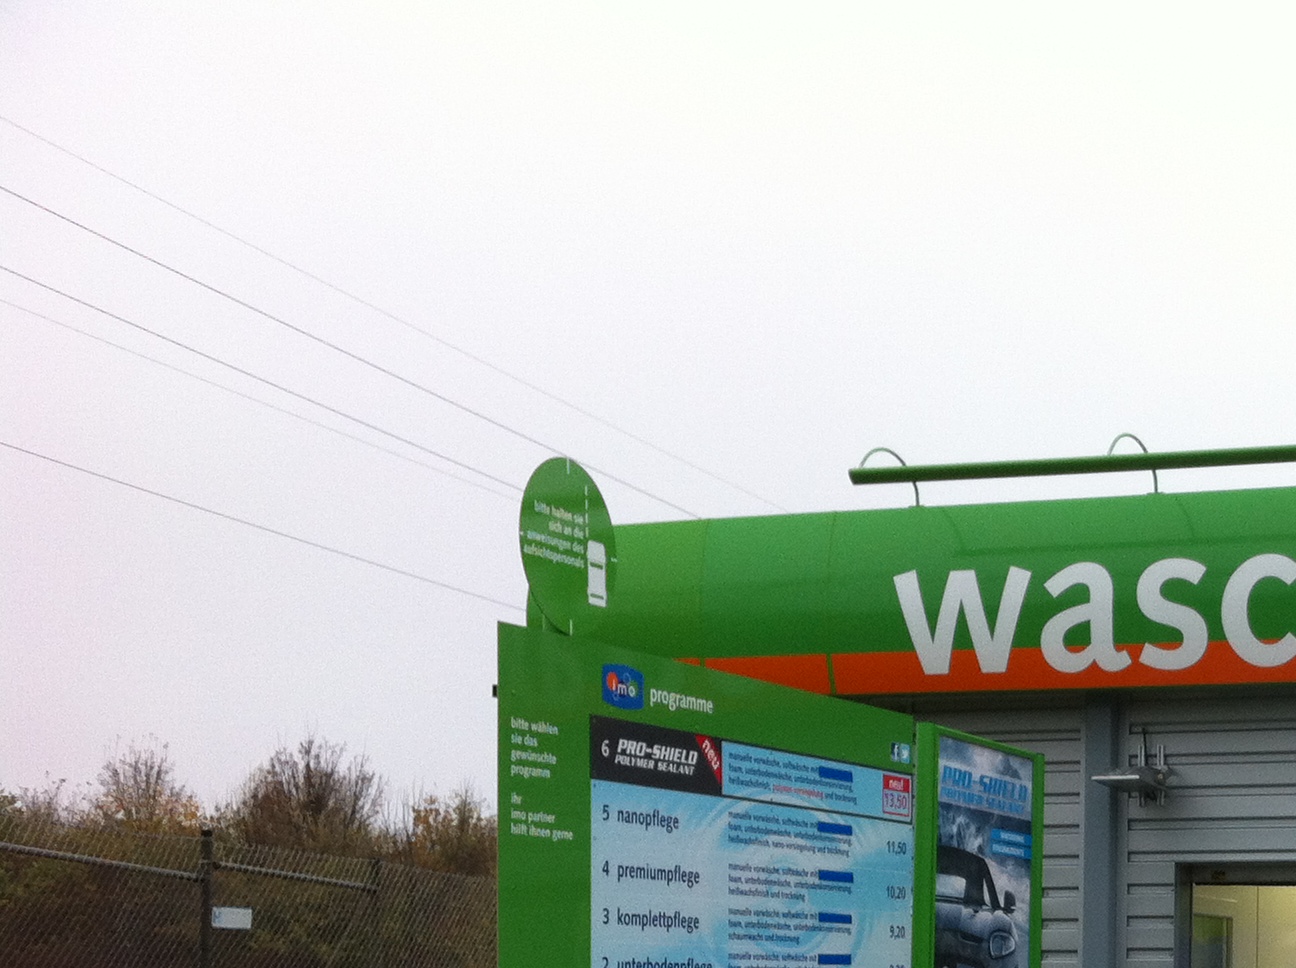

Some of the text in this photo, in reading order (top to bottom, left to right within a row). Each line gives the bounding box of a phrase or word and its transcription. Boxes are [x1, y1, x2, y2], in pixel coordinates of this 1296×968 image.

[650, 688, 715, 714] programme
[511, 717, 559, 735] bitte wählen
[511, 734, 538, 747] sie das
[601, 738, 699, 766] 6 PRO-SHIELD
[702, 739, 721, 771] neu
[615, 755, 696, 776] POLYMER SEALANT
[889, 779, 904, 791] neu!
[603, 805, 680, 834] 5 nanopflege
[887, 840, 907, 855] 11,50
[602, 861, 700, 889] 4 premiumpflege
[887, 886, 906, 900] 10,20
[603, 908, 700, 934] 3 komplettpflege
[890, 926, 906, 940] 9,20
